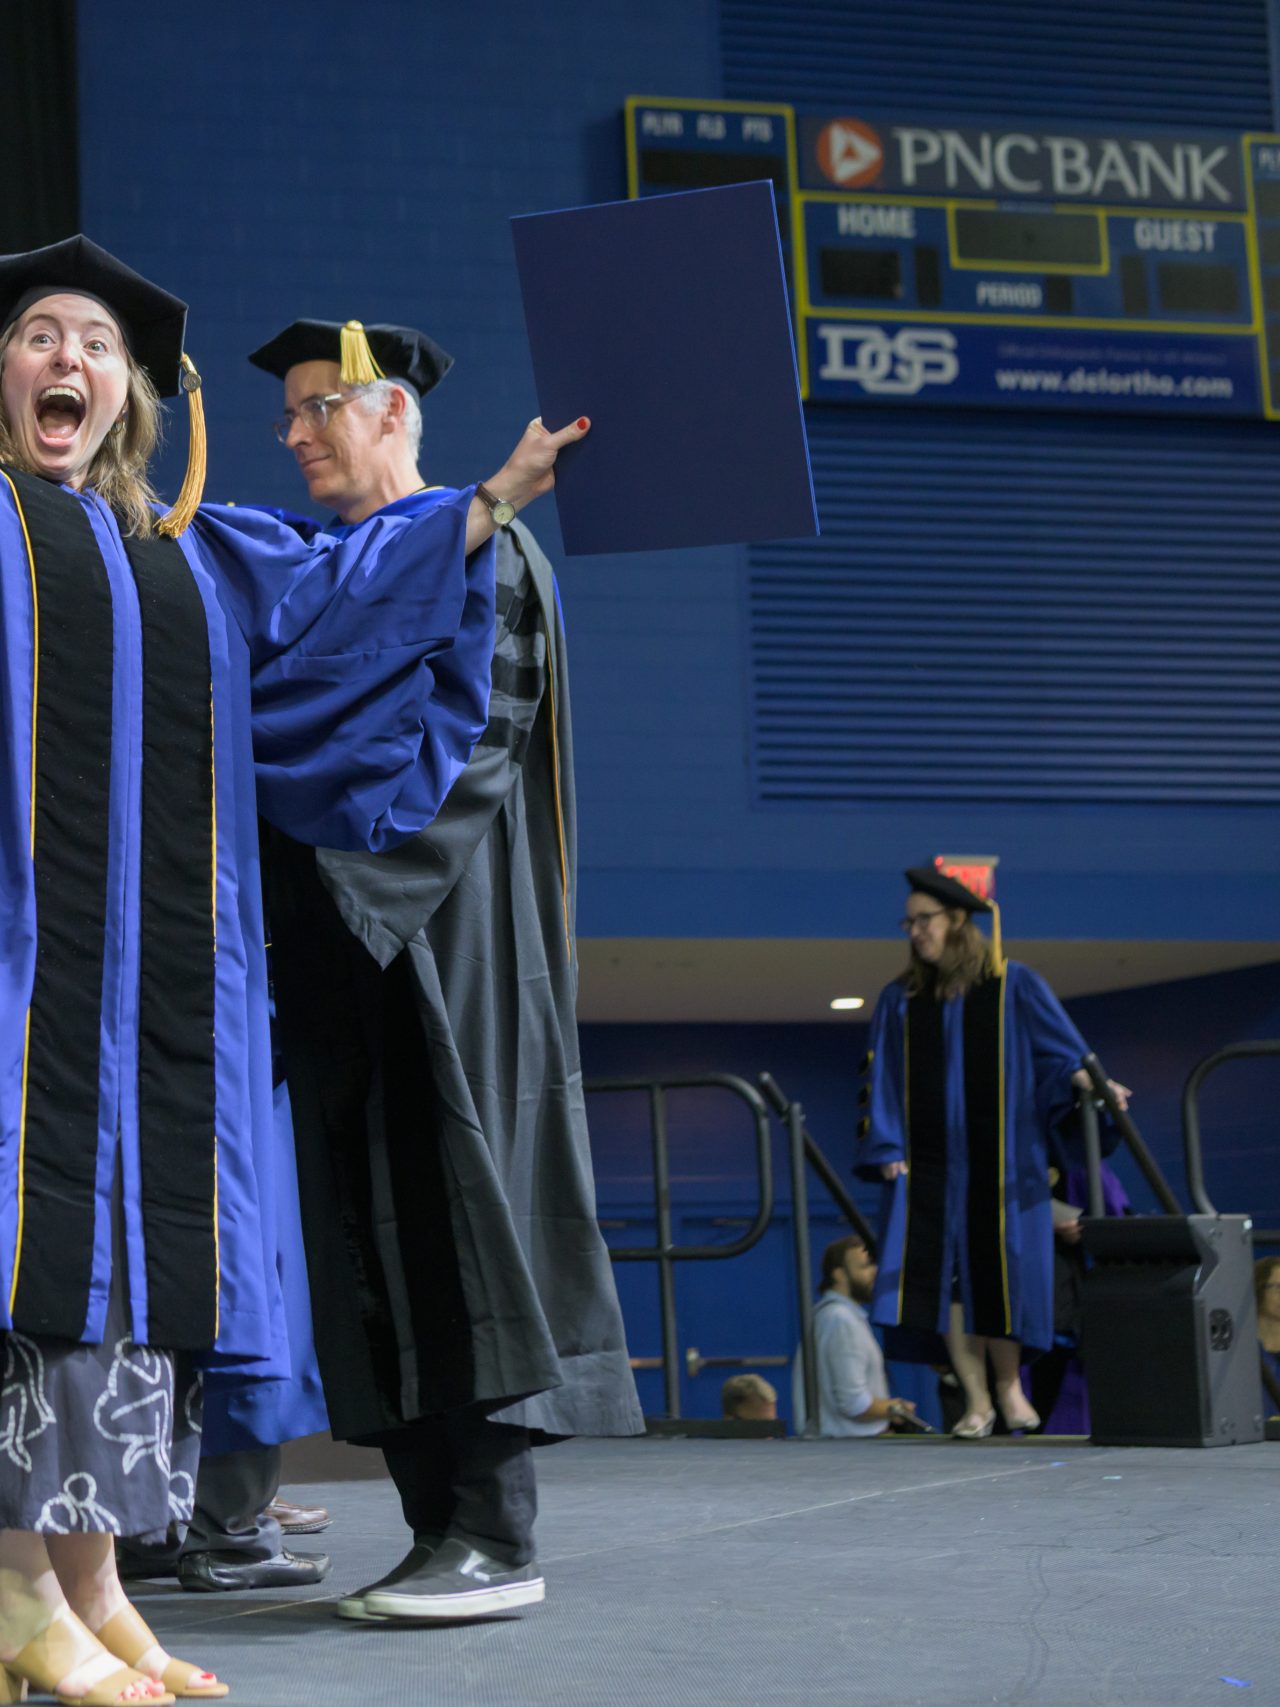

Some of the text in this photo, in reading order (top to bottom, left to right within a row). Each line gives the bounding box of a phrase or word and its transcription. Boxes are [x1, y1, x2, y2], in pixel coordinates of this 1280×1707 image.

[893, 127, 1231, 203] PNC BANK
[837, 204, 916, 239] HOME
[1134, 218, 1219, 252] GUEST
[975, 281, 1044, 308] PERIOD
[995, 366, 1233, 398] www.delortho.com
